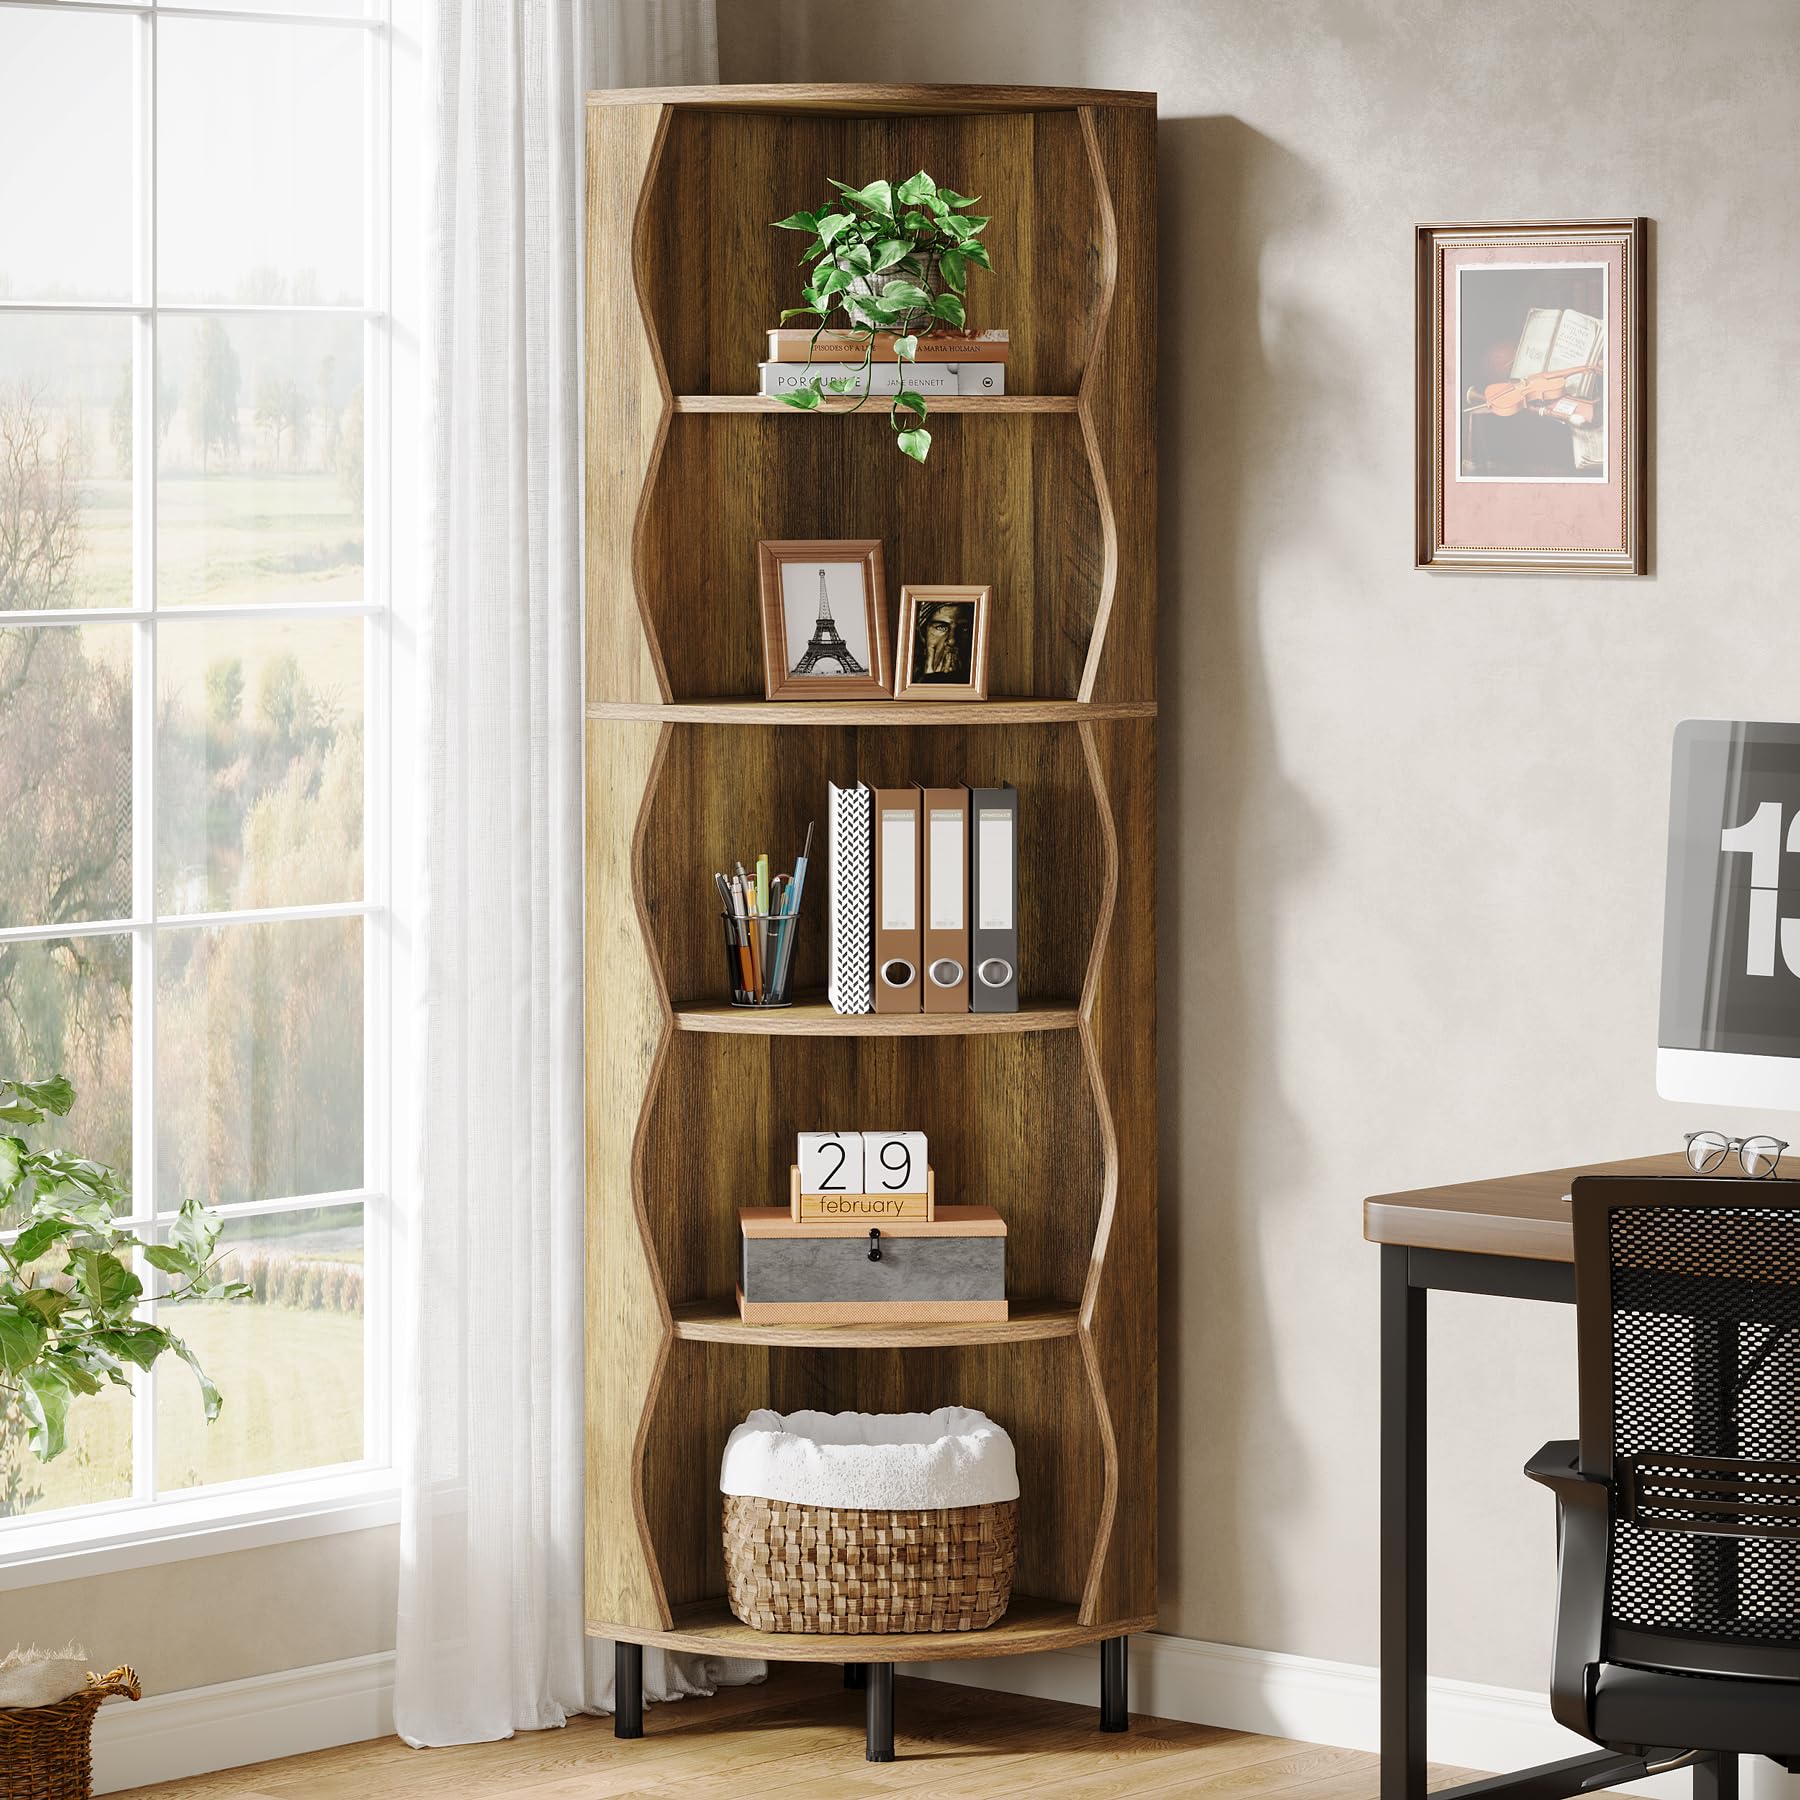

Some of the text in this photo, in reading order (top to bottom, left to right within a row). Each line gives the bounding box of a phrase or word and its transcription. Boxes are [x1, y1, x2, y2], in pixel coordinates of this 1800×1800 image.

[811, 344, 843, 352] PISODES
[843, 344, 854, 352] OF
[855, 344, 860, 352] A
[778, 376, 861, 387] PORCUE
[819, 1196, 904, 1217] february
